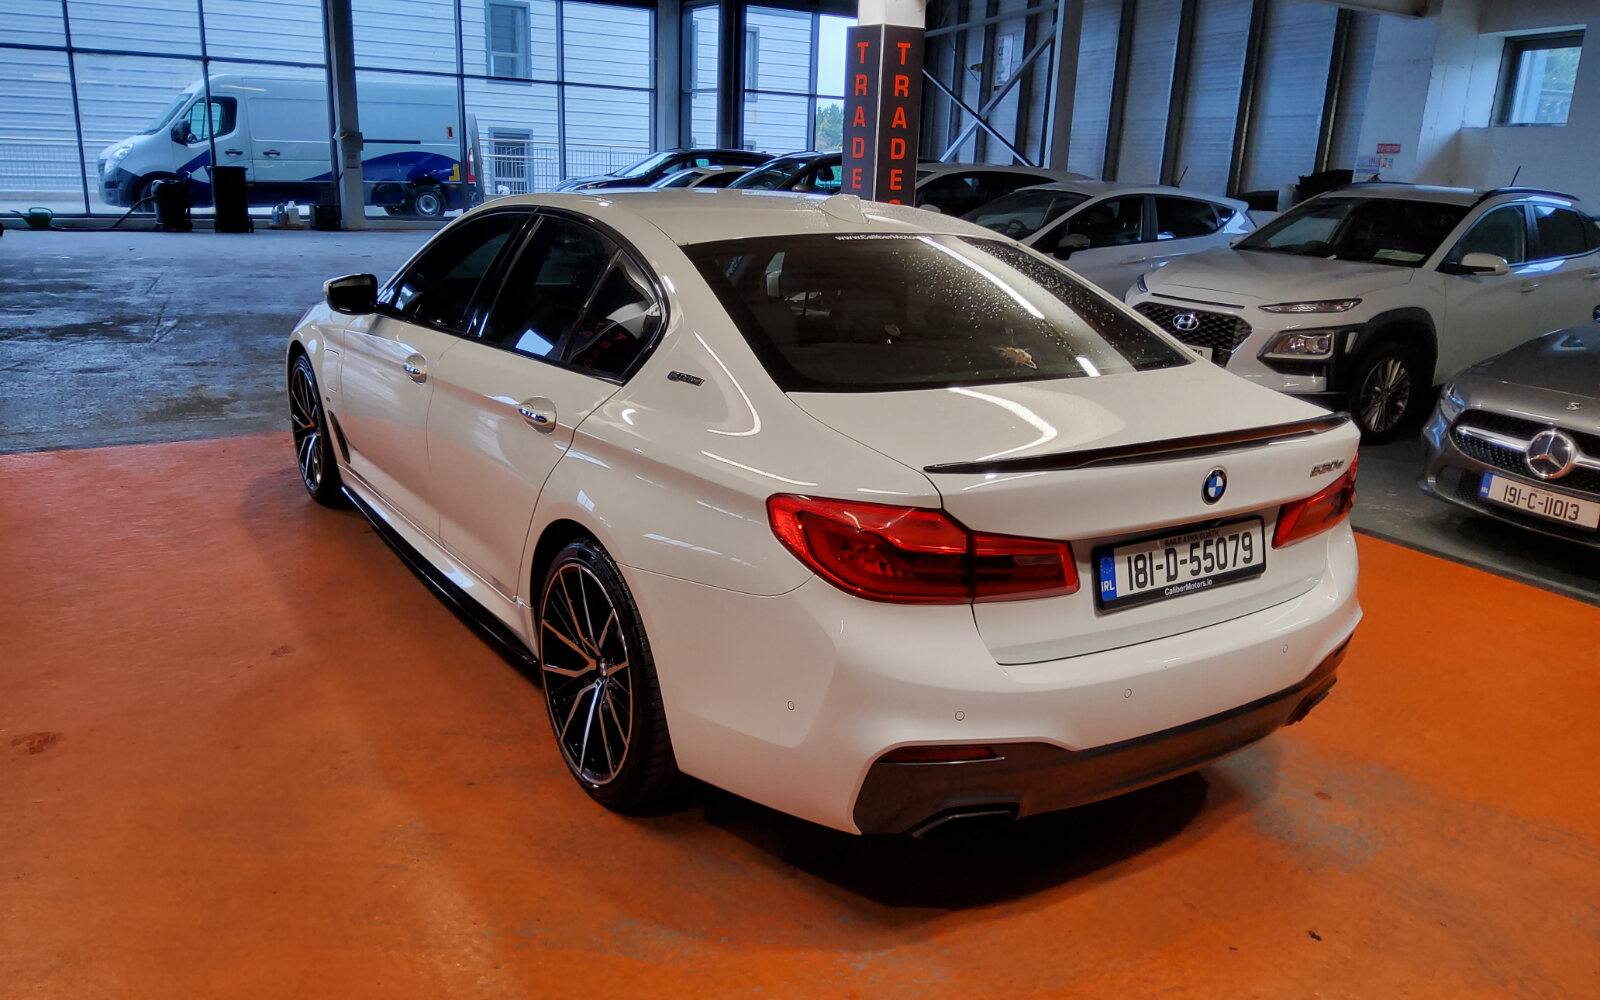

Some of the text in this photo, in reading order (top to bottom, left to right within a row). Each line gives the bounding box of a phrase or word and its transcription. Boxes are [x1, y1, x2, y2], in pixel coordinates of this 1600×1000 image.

[1503, 484, 1580, 521] 191-C-11013
[1127, 531, 1254, 591] 181-D-55079
[1101, 580, 1115, 593] IRL
